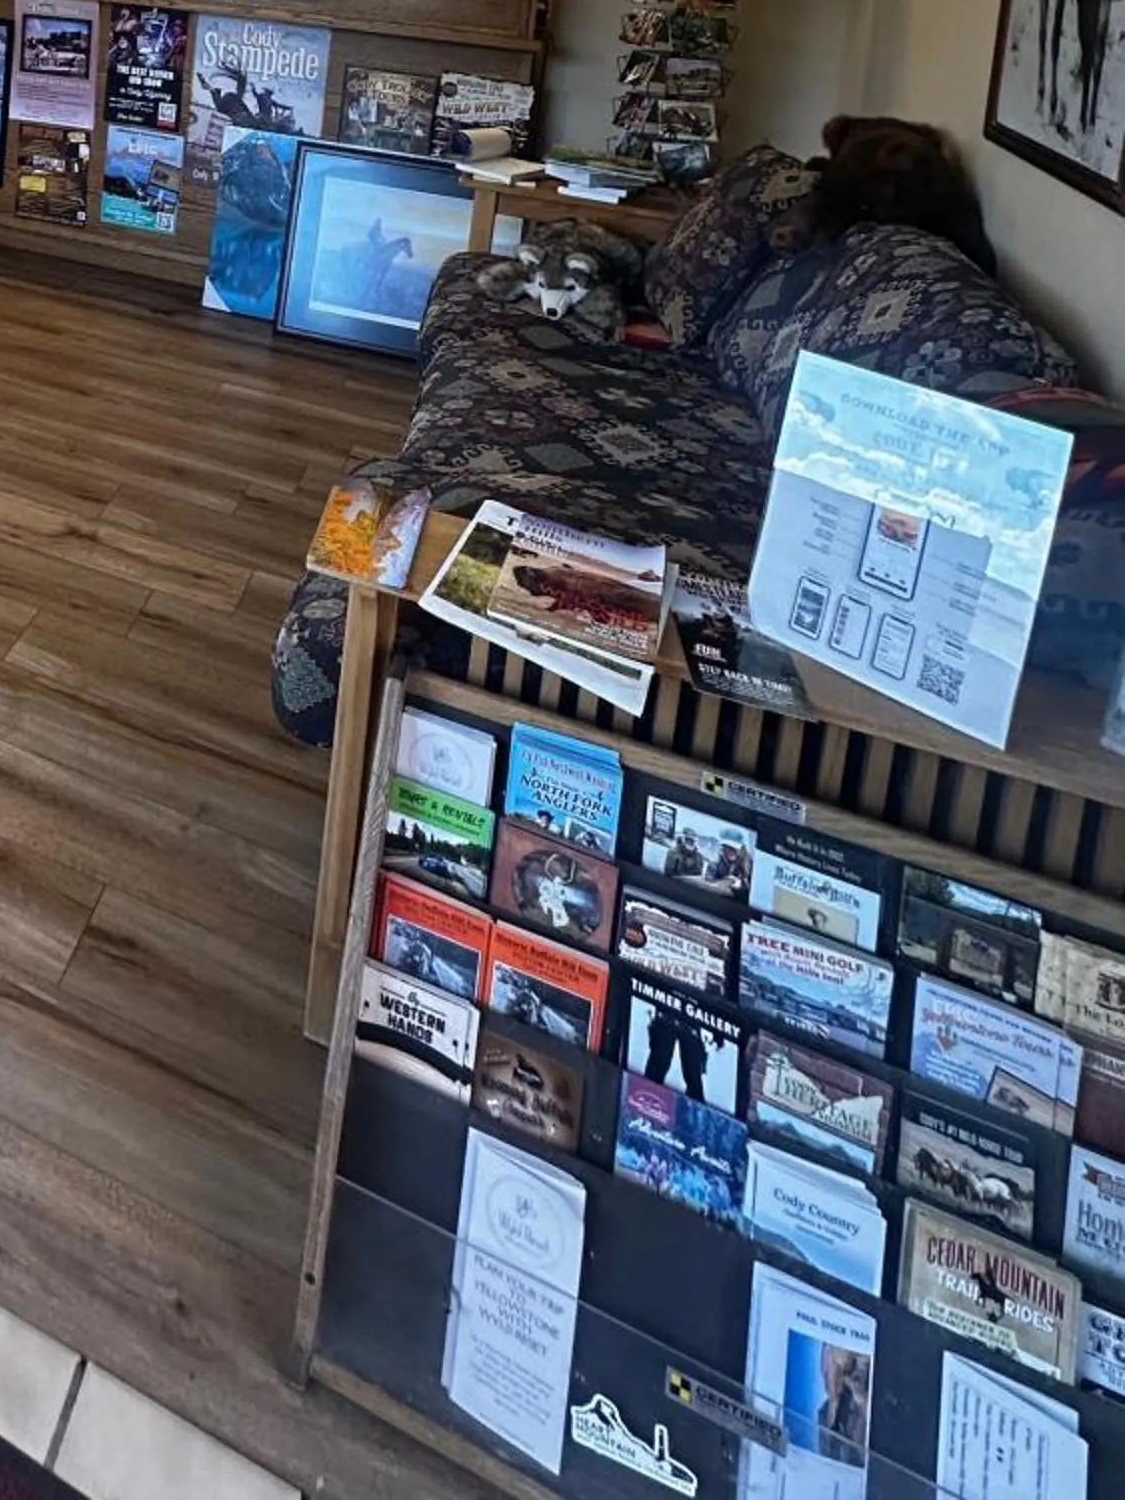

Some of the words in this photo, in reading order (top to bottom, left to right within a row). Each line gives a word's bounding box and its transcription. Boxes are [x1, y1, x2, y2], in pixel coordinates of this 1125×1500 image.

[202, 31, 320, 81] Stampede
[243, 23, 282, 49] Cody
[840, 393, 930, 430] DOWNLOAD
[934, 423, 971, 444] THE
[521, 774, 570, 800] NORTH
[572, 794, 613, 816] FORK
[531, 790, 598, 821] ANGLERS
[727, 781, 801, 812] CERTIFIED
[747, 932, 790, 953] FREE
[792, 945, 824, 963] MINI
[826, 954, 864, 974] GOLF
[380, 991, 446, 1034] WESTERN
[388, 1012, 433, 1045] HANDS
[631, 977, 682, 1012] TIMMER
[685, 1003, 740, 1039] GALLERY
[773, 1187, 806, 1211] Cody
[808, 1203, 860, 1237] Country
[926, 1236, 975, 1276] CEDAR
[985, 1251, 1066, 1321] MOUNTAIN
[475, 1279, 560, 1340] YELLOWSTONE
[499, 1305, 532, 1336] WITH
[1003, 1297, 1055, 1334] RIDES
[694, 1384, 783, 1439] CERTIFIED
[575, 1421, 637, 1460] MOUNTAIN
